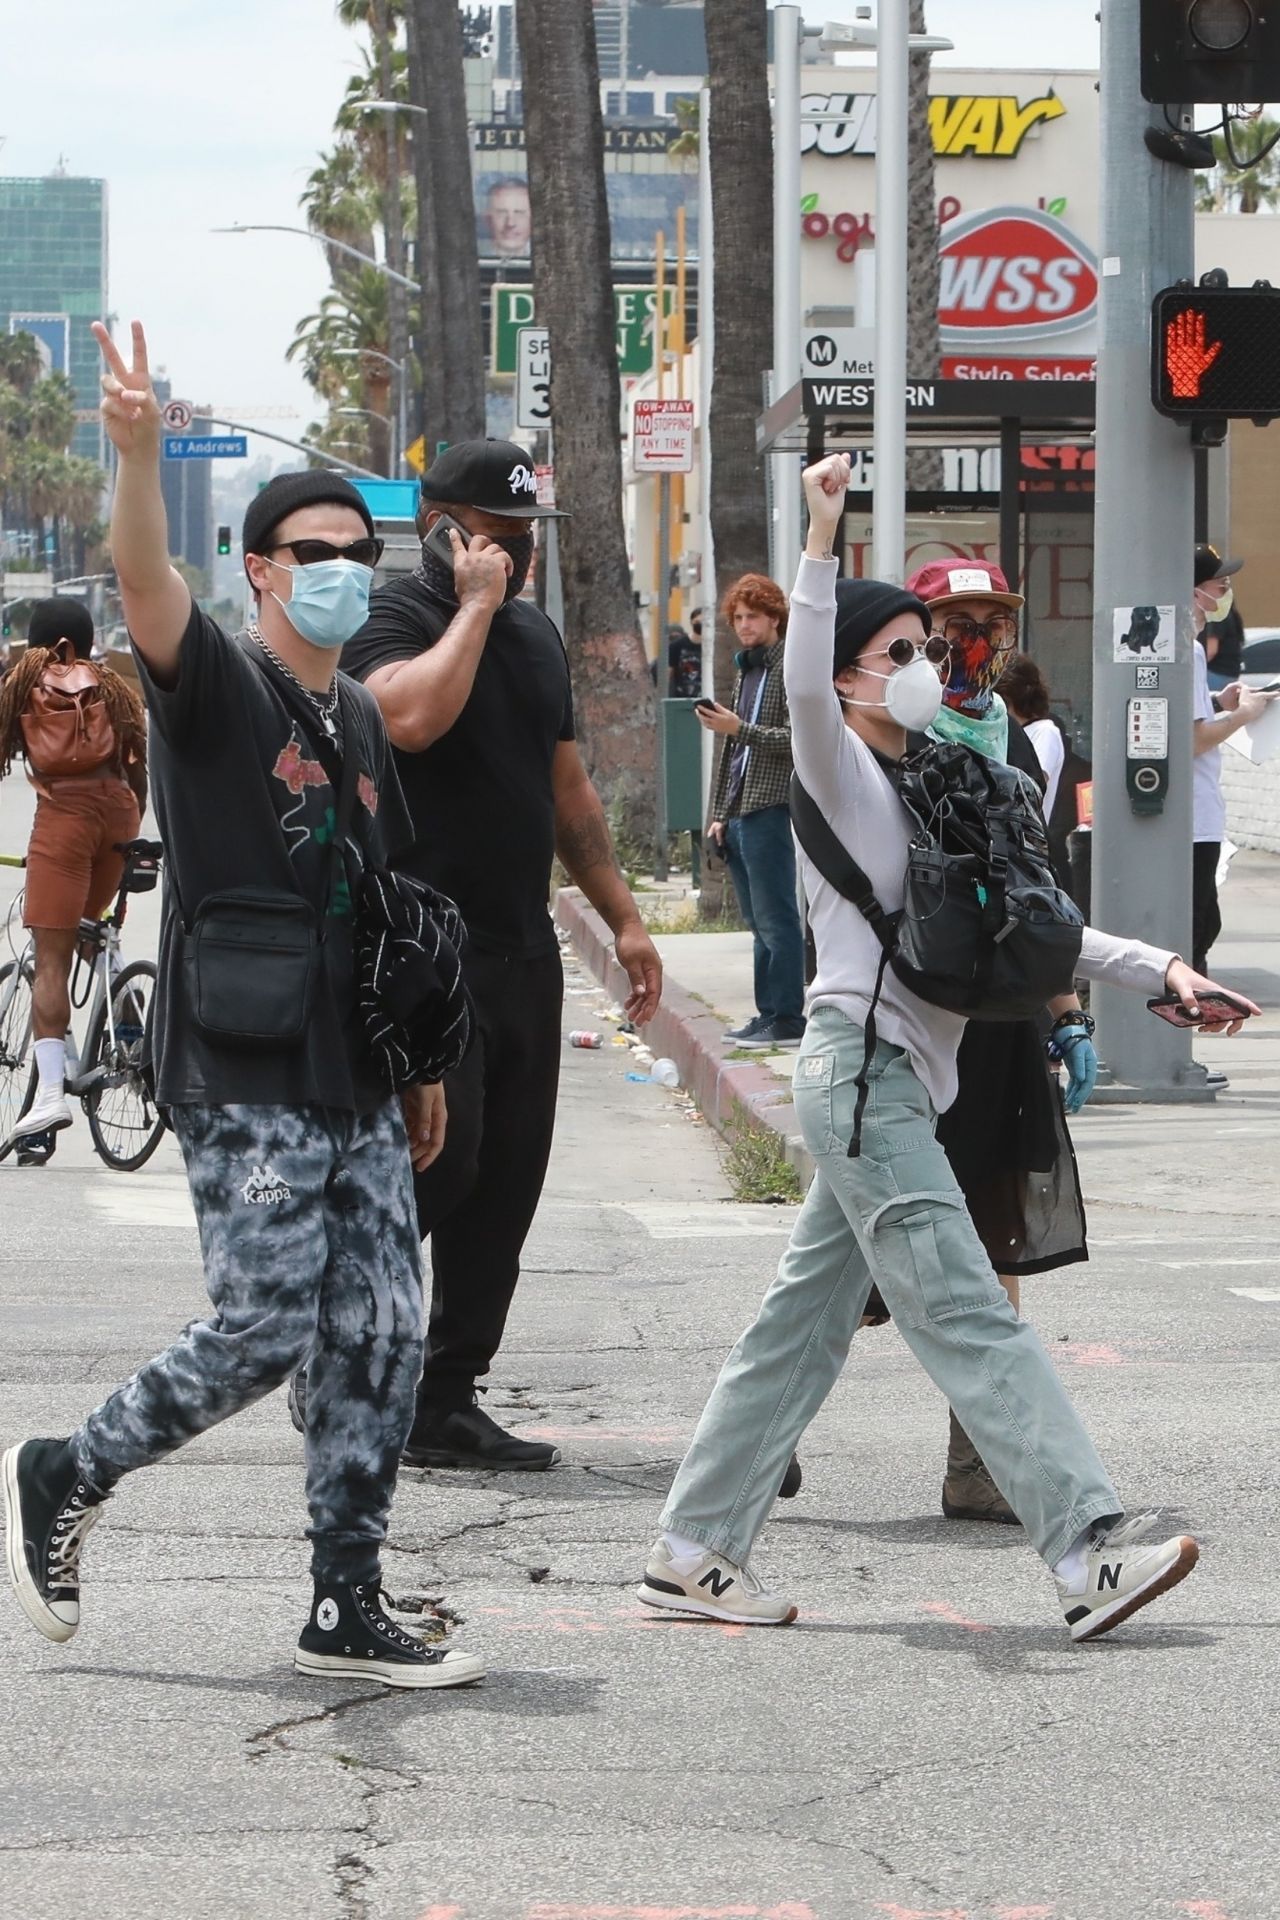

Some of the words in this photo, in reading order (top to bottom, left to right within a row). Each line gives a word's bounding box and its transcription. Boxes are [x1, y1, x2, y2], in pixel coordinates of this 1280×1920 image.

[939, 255, 1082, 313] WSS
[843, 360, 874, 373] Met
[812, 385, 935, 406] WESRN
[636, 402, 692, 412] TOW-AWAY
[635, 415, 651, 434] NO
[654, 418, 691, 431] STOPPING
[169, 442, 184, 454] St
[187, 441, 243, 454] Andrews
[641, 438, 659, 449] ANY
[665, 438, 686, 449] TIME
[243, 1187, 292, 1205] Kappa
[696, 1566, 736, 1598] N
[1097, 1562, 1123, 1592] N
